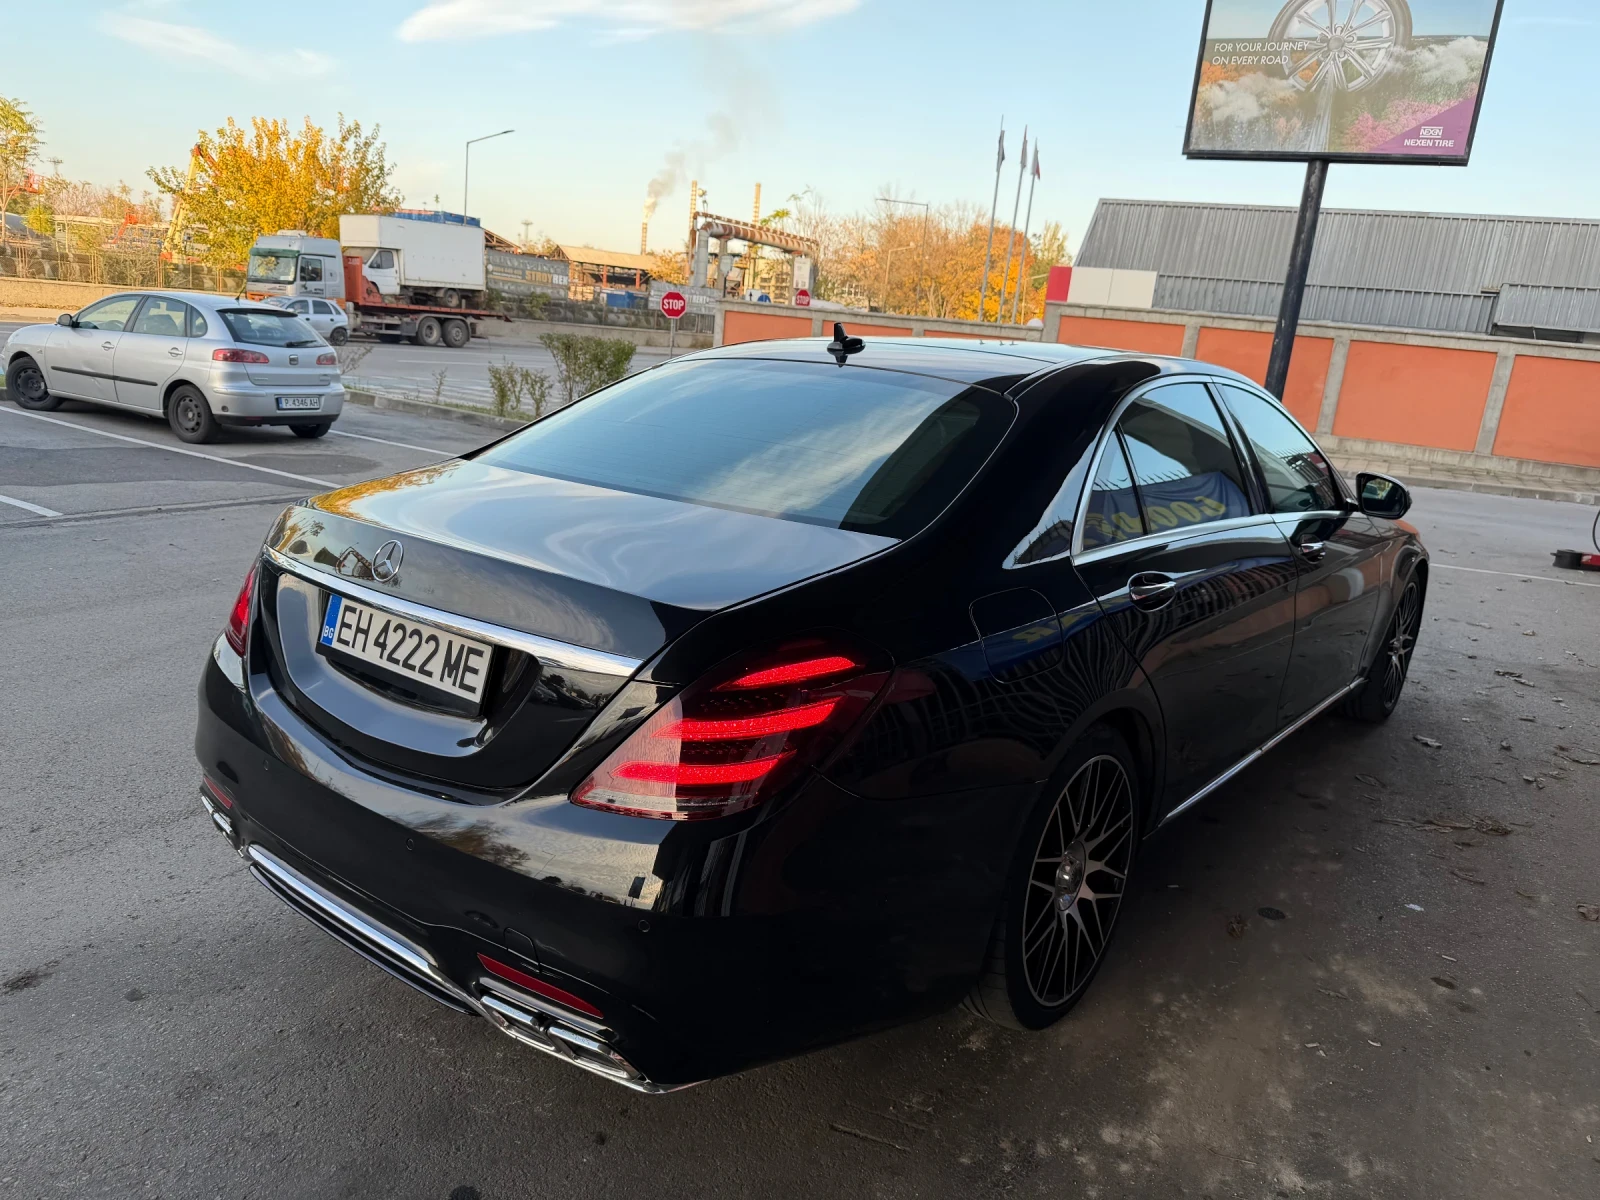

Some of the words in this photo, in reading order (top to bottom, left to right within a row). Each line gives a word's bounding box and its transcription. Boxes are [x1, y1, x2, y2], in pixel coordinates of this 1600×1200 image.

[1214, 43, 1233, 52] FOR
[1235, 42, 1262, 52] YOUR
[1263, 41, 1310, 51] JOURNEY
[1212, 56, 1229, 65] ON
[1231, 55, 1259, 65] EVERY
[1260, 55, 1289, 65] ROAD
[1404, 138, 1433, 146] NEXEN
[1434, 139, 1454, 147] TIRE
[663, 298, 684, 311] STOP
[796, 295, 810, 305] STOP
[322, 625, 335, 638] BG
[336, 604, 373, 653] EH
[373, 619, 440, 678] 4222
[439, 640, 485, 694] ME
